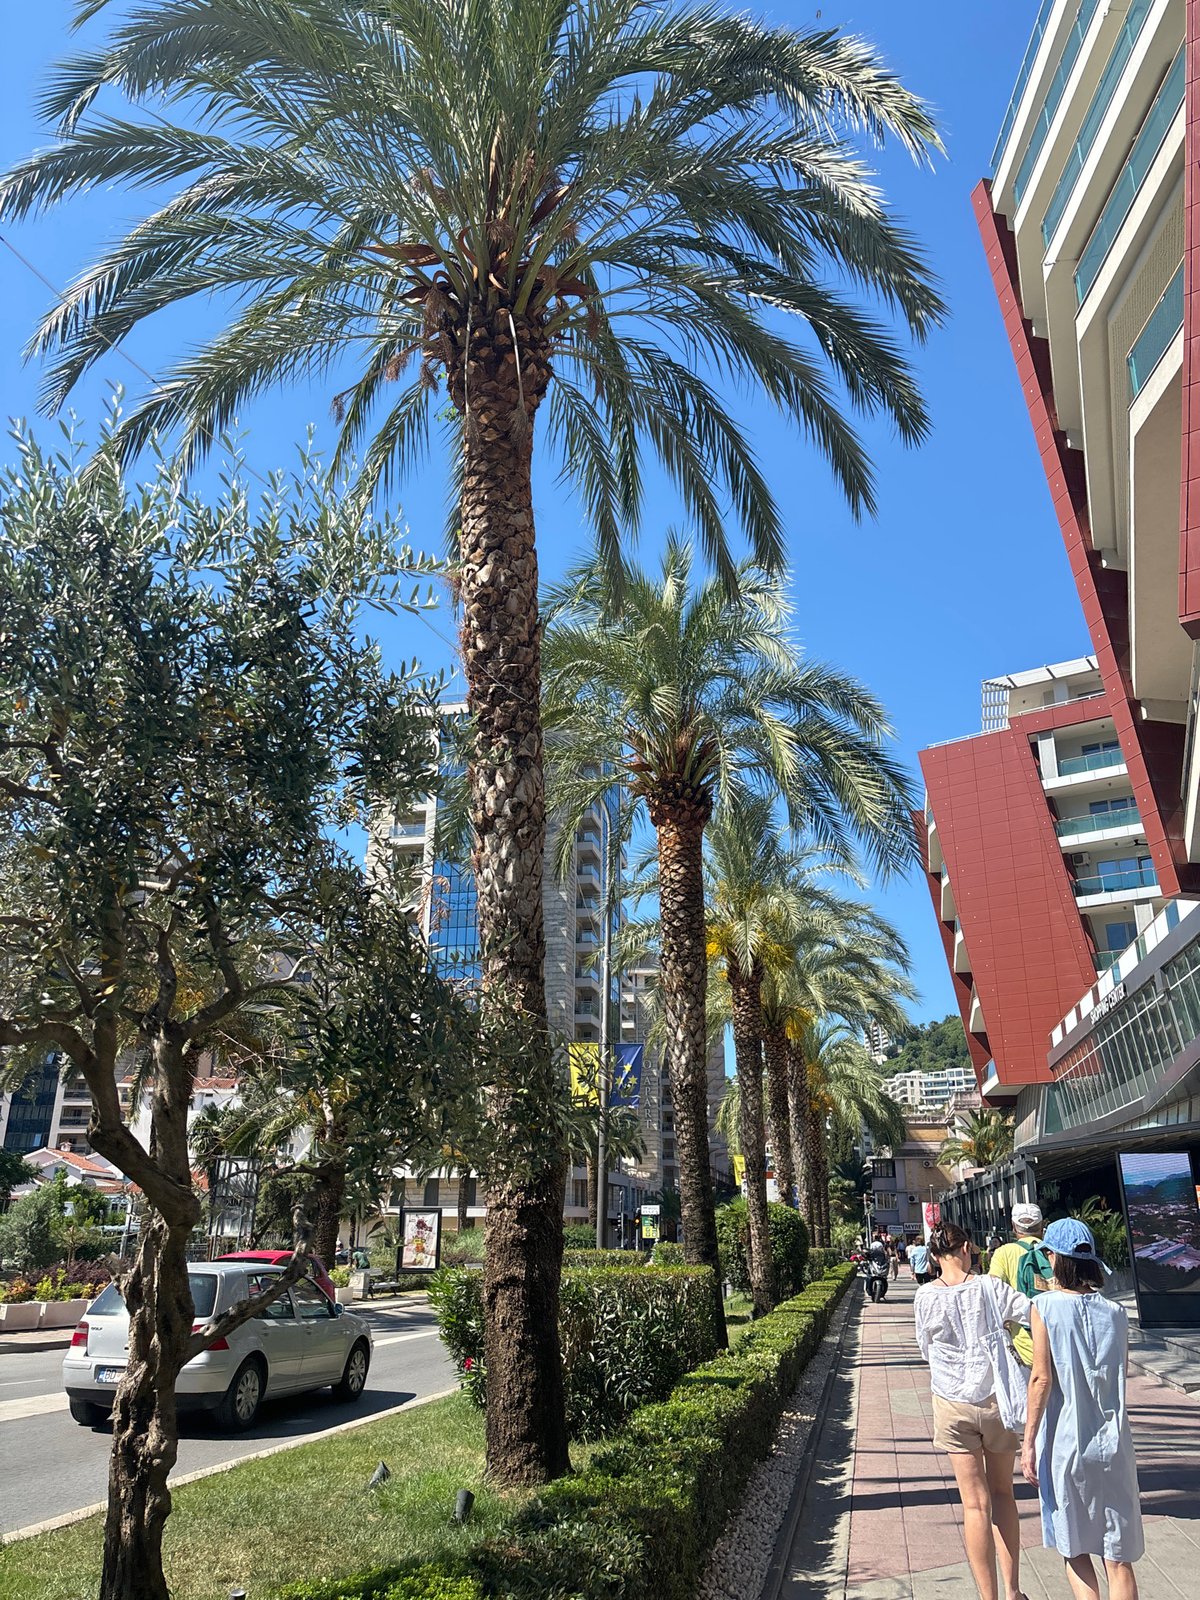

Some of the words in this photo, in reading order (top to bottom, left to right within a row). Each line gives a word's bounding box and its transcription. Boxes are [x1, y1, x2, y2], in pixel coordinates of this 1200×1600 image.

[1089, 997, 1110, 1025] SHOPPING
[1108, 982, 1126, 1009] CENTER
[643, 1076, 652, 1129] APART
